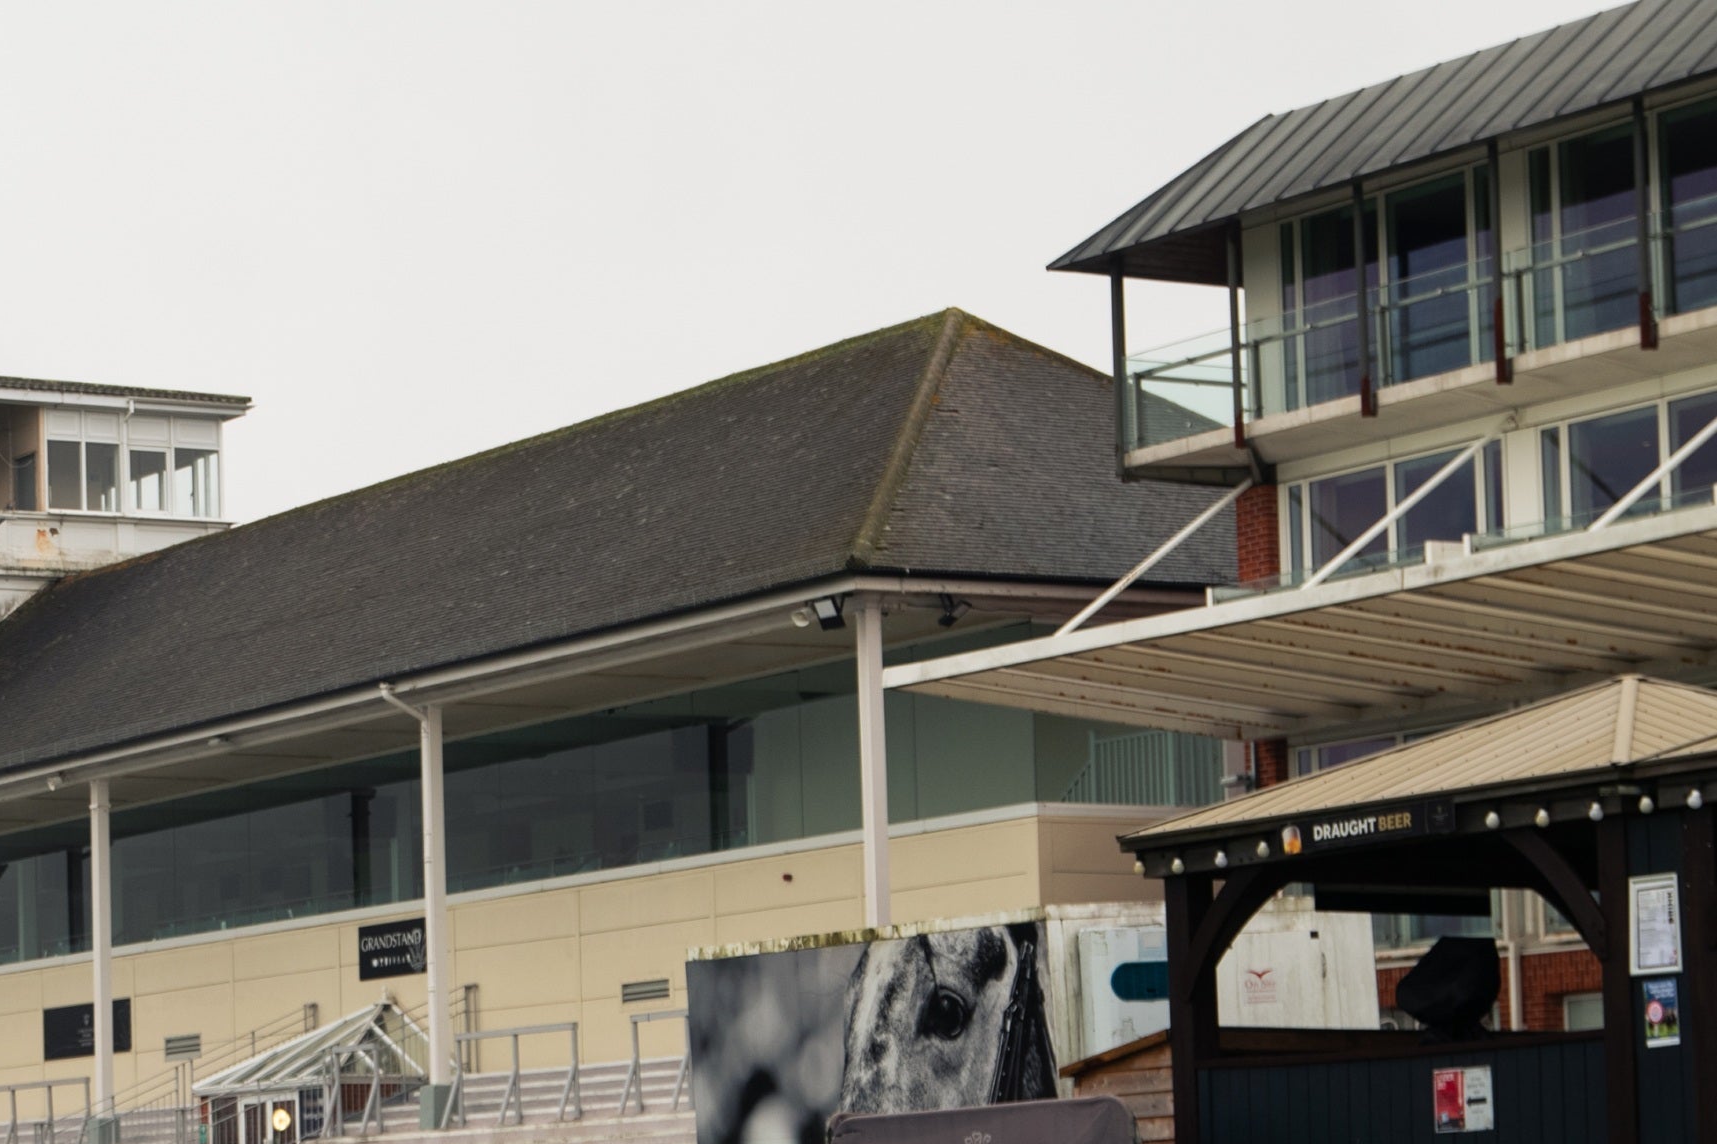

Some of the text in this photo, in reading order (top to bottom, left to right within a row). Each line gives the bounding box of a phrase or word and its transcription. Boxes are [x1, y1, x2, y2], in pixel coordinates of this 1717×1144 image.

[1313, 816, 1377, 842] DRAUGHT
[1378, 811, 1412, 832] BEER
[361, 928, 422, 953] GRANDSTAND
